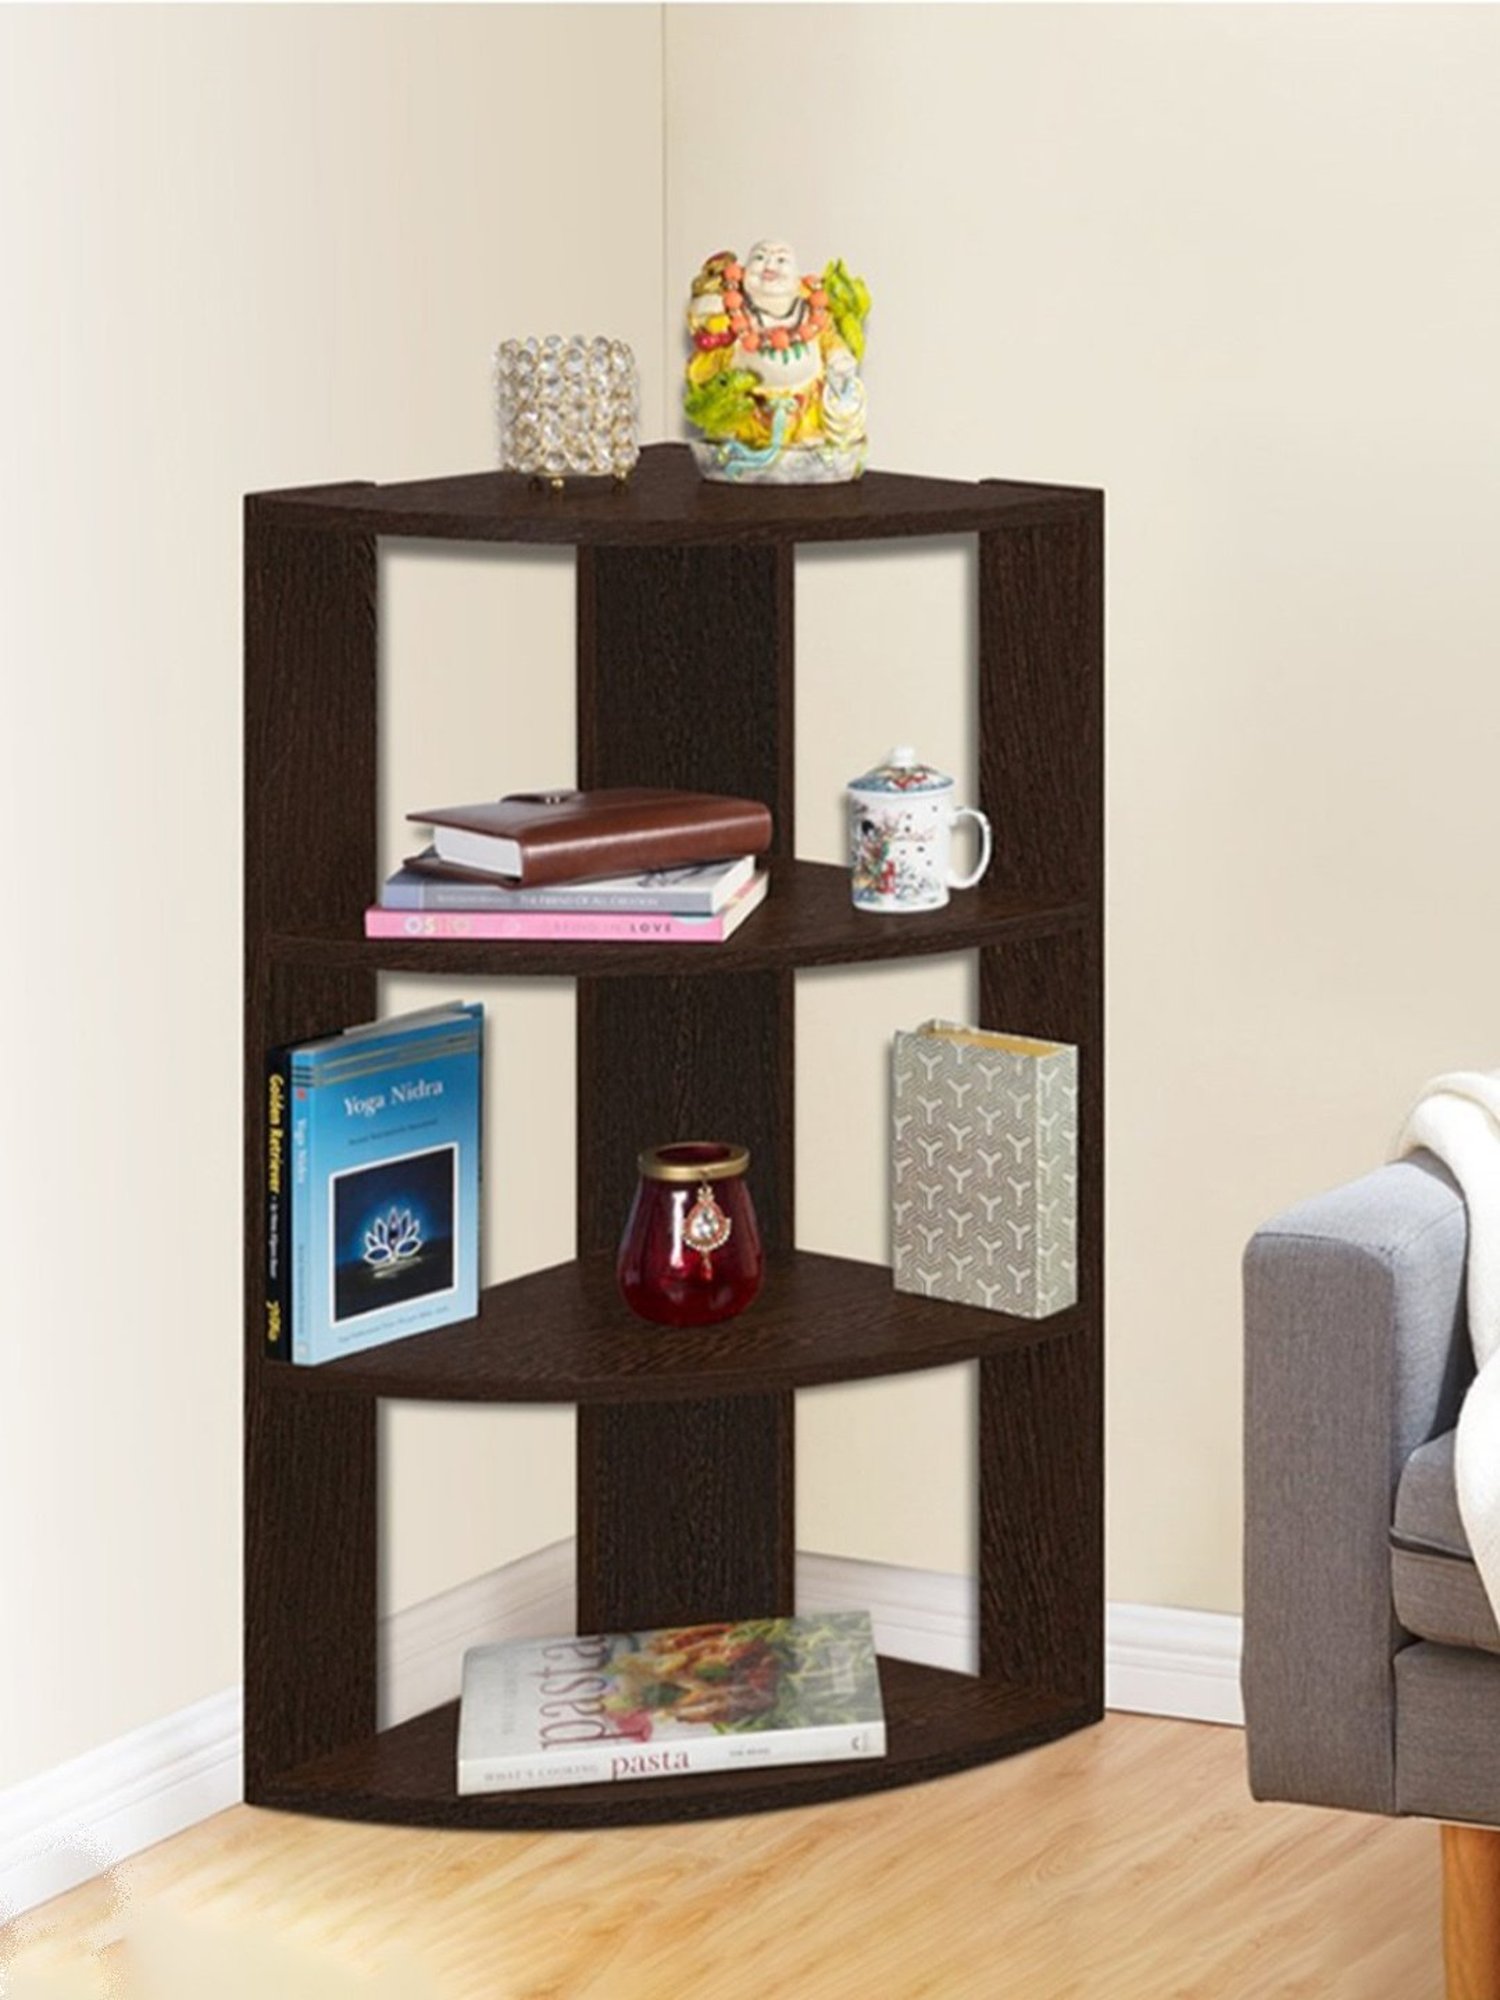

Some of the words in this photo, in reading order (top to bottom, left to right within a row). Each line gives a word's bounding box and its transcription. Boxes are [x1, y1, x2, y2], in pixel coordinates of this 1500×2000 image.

[628, 922, 672, 934] LOVE
[269, 1073, 285, 1125] Golden
[343, 1095, 386, 1118] Yoga
[389, 1079, 443, 1105] Nidra
[269, 1127, 284, 1194] Retriever
[530, 1636, 652, 1750] pasta
[611, 1752, 690, 1782] pasta
